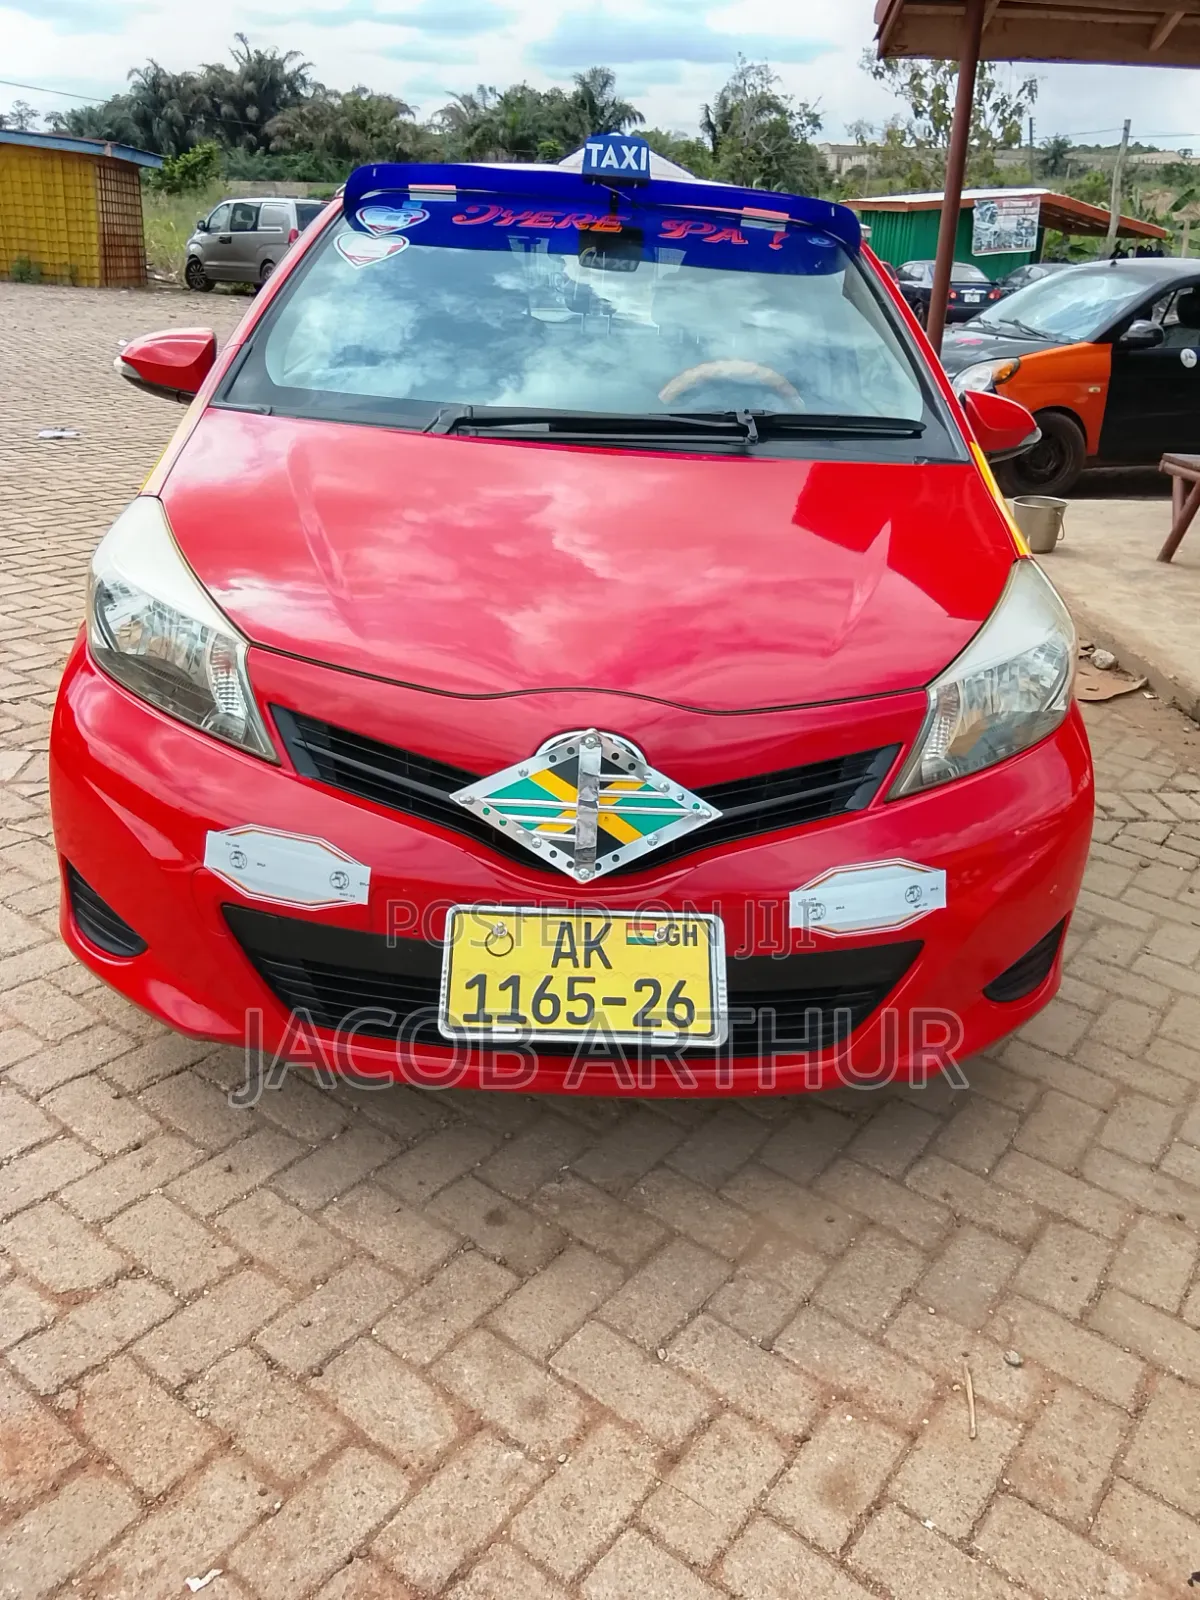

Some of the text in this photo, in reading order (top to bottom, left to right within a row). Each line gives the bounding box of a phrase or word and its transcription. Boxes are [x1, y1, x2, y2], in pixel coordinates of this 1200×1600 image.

[586, 143, 648, 171] TAXI
[551, 921, 612, 969] AK
[665, 923, 698, 946] GH
[462, 974, 696, 1028] 1165-26
